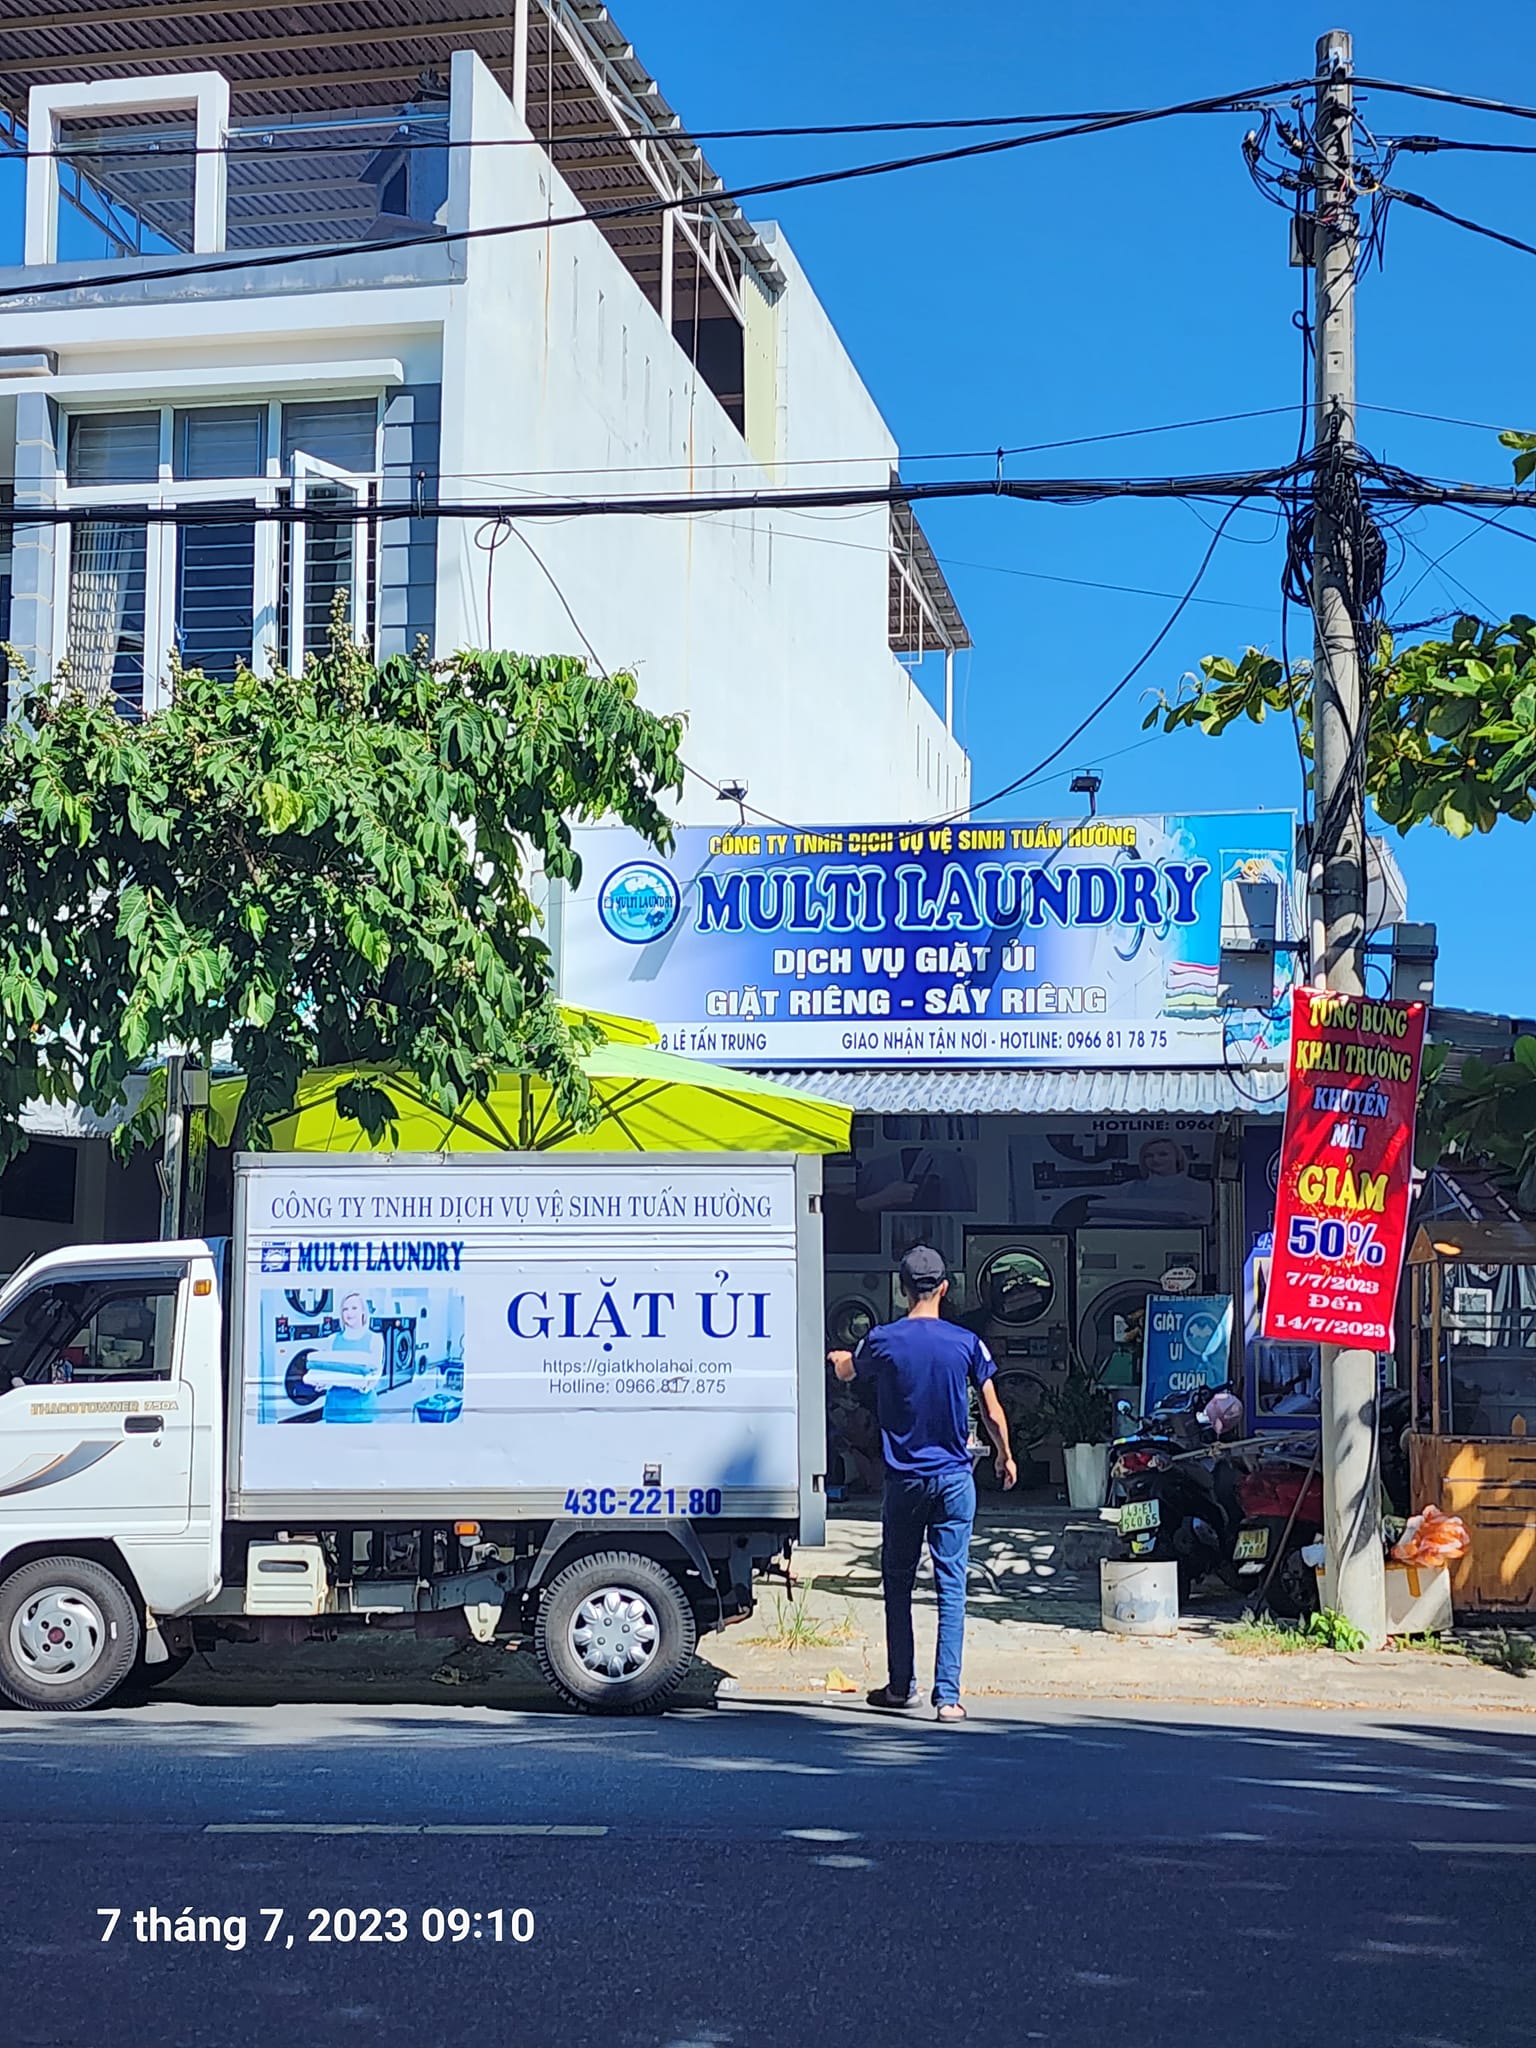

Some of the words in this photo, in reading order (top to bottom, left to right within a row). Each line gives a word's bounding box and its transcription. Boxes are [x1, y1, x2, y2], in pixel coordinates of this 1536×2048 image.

[709, 832, 761, 855] CÔNG
[766, 834, 787, 854] TY
[793, 832, 843, 854] TNHH
[849, 832, 893, 857] DỊCH
[899, 829, 923, 856] VỤ
[929, 827, 953, 855] VỆ
[959, 829, 1005, 850] SINH
[1011, 821, 1063, 850] TUẤN
[1068, 822, 1136, 848] HƯỜNG
[695, 867, 886, 934] MULTI
[896, 861, 1211, 930] LAUNDRY
[773, 947, 852, 979] DỊCH
[861, 947, 905, 979] VỤ
[915, 941, 992, 979] GIẶT
[1004, 936, 1036, 972] ỦI
[705, 984, 779, 1020] GIẶT
[790, 983, 890, 1015] RIÊNG
[899, 997, 914, 1006] -
[925, 978, 993, 1014] SẤY
[1001, 982, 1107, 1014] RIÊNG
[673, 1029, 686, 1050] LÊ
[690, 1026, 717, 1050] TẤN
[721, 1033, 767, 1050] TRUNG
[842, 1032, 878, 1049] GIAO
[883, 1028, 924, 1054] NHẬN
[929, 1027, 956, 1055] TẬN
[961, 1029, 987, 1049] NƠI
[1000, 1030, 1062, 1049] HOTLINE:
[1067, 1030, 1102, 1048] 0966
[1106, 1030, 1122, 1048] 81
[1128, 1030, 1147, 1048] 78
[1150, 1030, 1167, 1048] 75
[1295, 1040, 1342, 1072] KHAI
[1092, 1120, 1169, 1131] HOTLINE:
[1330, 1119, 1367, 1150] MÃI
[1298, 1154, 1389, 1213] GIẢM
[271, 1190, 332, 1219] CÔNG
[338, 1196, 366, 1218] TY
[370, 1196, 433, 1218] TNHH
[439, 1196, 494, 1223] DỊCH
[500, 1196, 530, 1223] VỤ
[535, 1189, 564, 1223] VỆ
[569, 1196, 621, 1217] SINH
[627, 1186, 687, 1217] TUẤN
[694, 1187, 772, 1217] HƯỜNG
[297, 1241, 360, 1272] MULTI
[366, 1241, 464, 1272] LAUNDRY
[1287, 1215, 1386, 1267] 50%
[1286, 1271, 1380, 1295] 7/7/2023
[507, 1276, 675, 1352] GIẶT
[695, 1269, 771, 1339] ỦI
[1307, 1293, 1362, 1312] Đến
[1153, 1310, 1183, 1335] GIẶT
[1274, 1314, 1386, 1338] 14/7/2023
[543, 1359, 732, 1377] https://giatkholahoi.com
[549, 1379, 610, 1394] Hotline:
[615, 1378, 726, 1394] 0966.817.875
[564, 1487, 723, 1516] 43C-221.80
